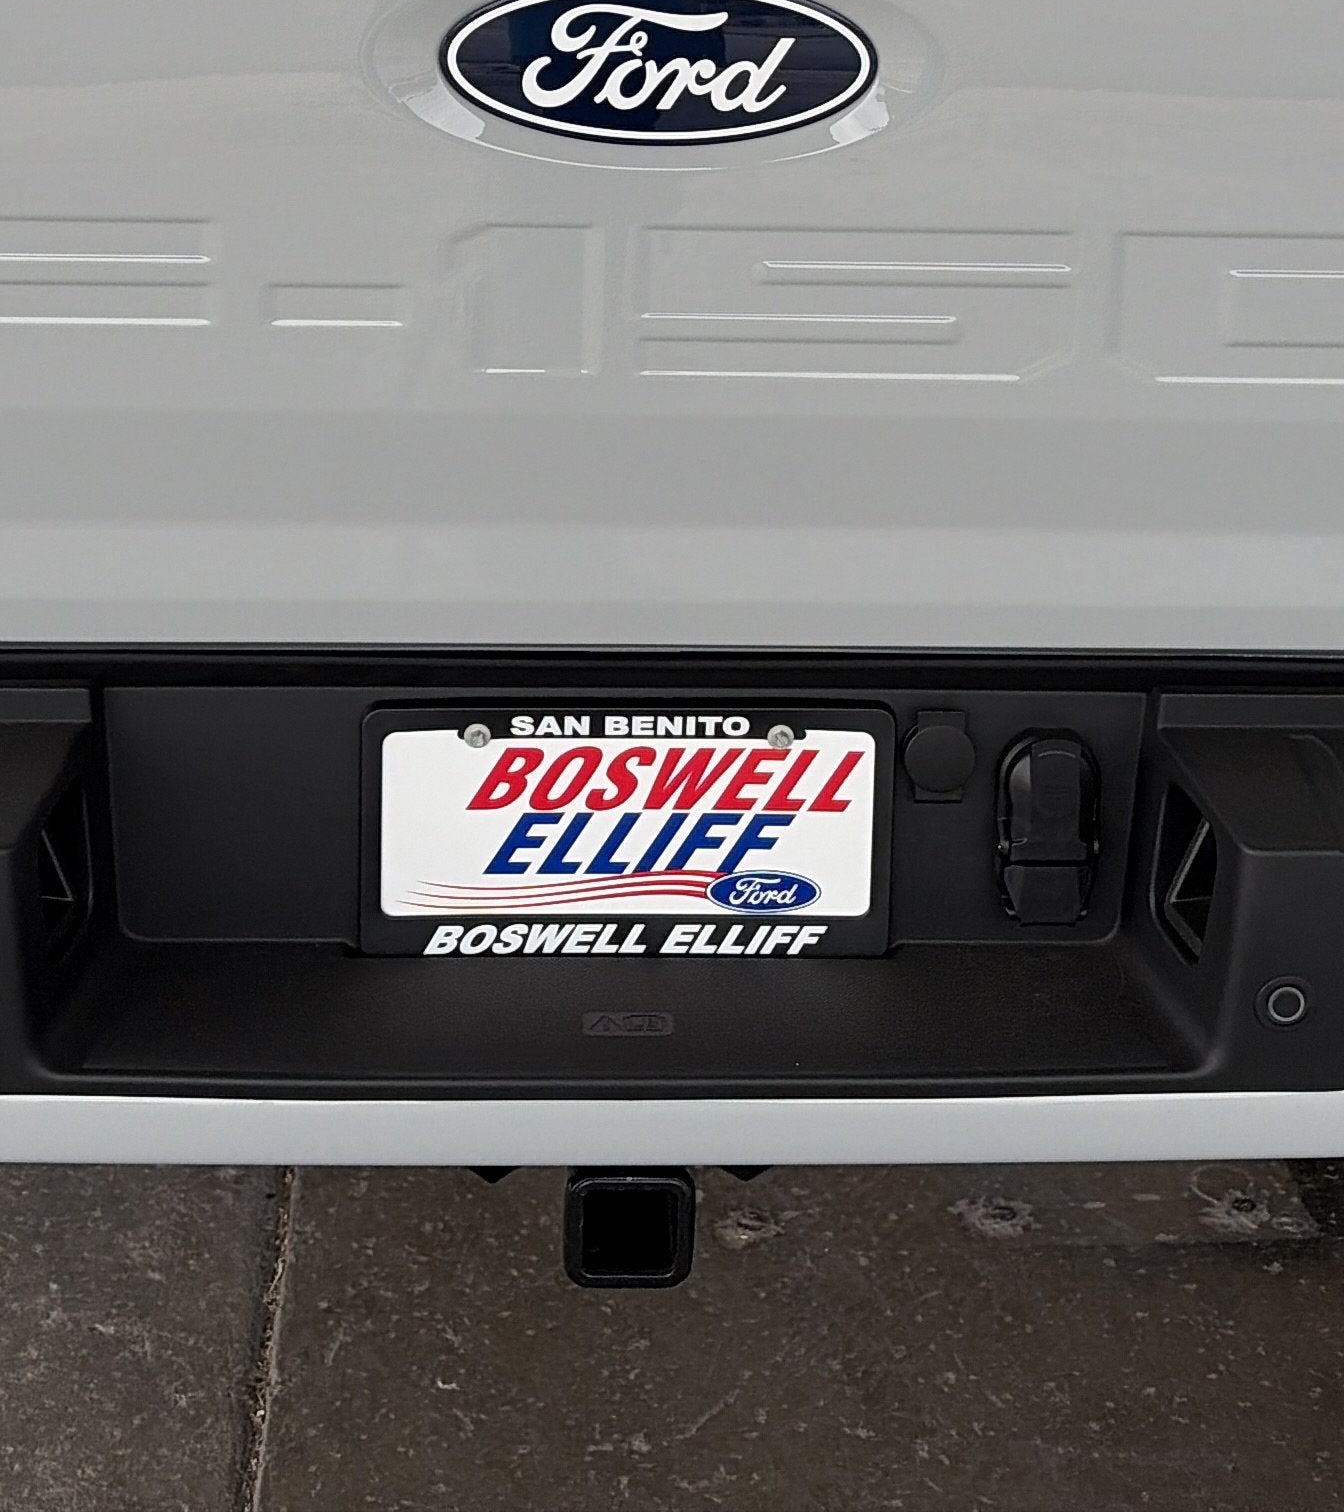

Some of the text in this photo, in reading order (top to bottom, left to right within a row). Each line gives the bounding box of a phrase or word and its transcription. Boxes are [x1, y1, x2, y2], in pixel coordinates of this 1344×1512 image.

[521, 3, 797, 113] Ford
[510, 715, 751, 737] SAN BENITO
[465, 746, 866, 813] BOSWELL
[482, 811, 797, 876] ELLIFF
[727, 877, 797, 907] Ford
[422, 923, 829, 956] BOSWELL ELLIFF
